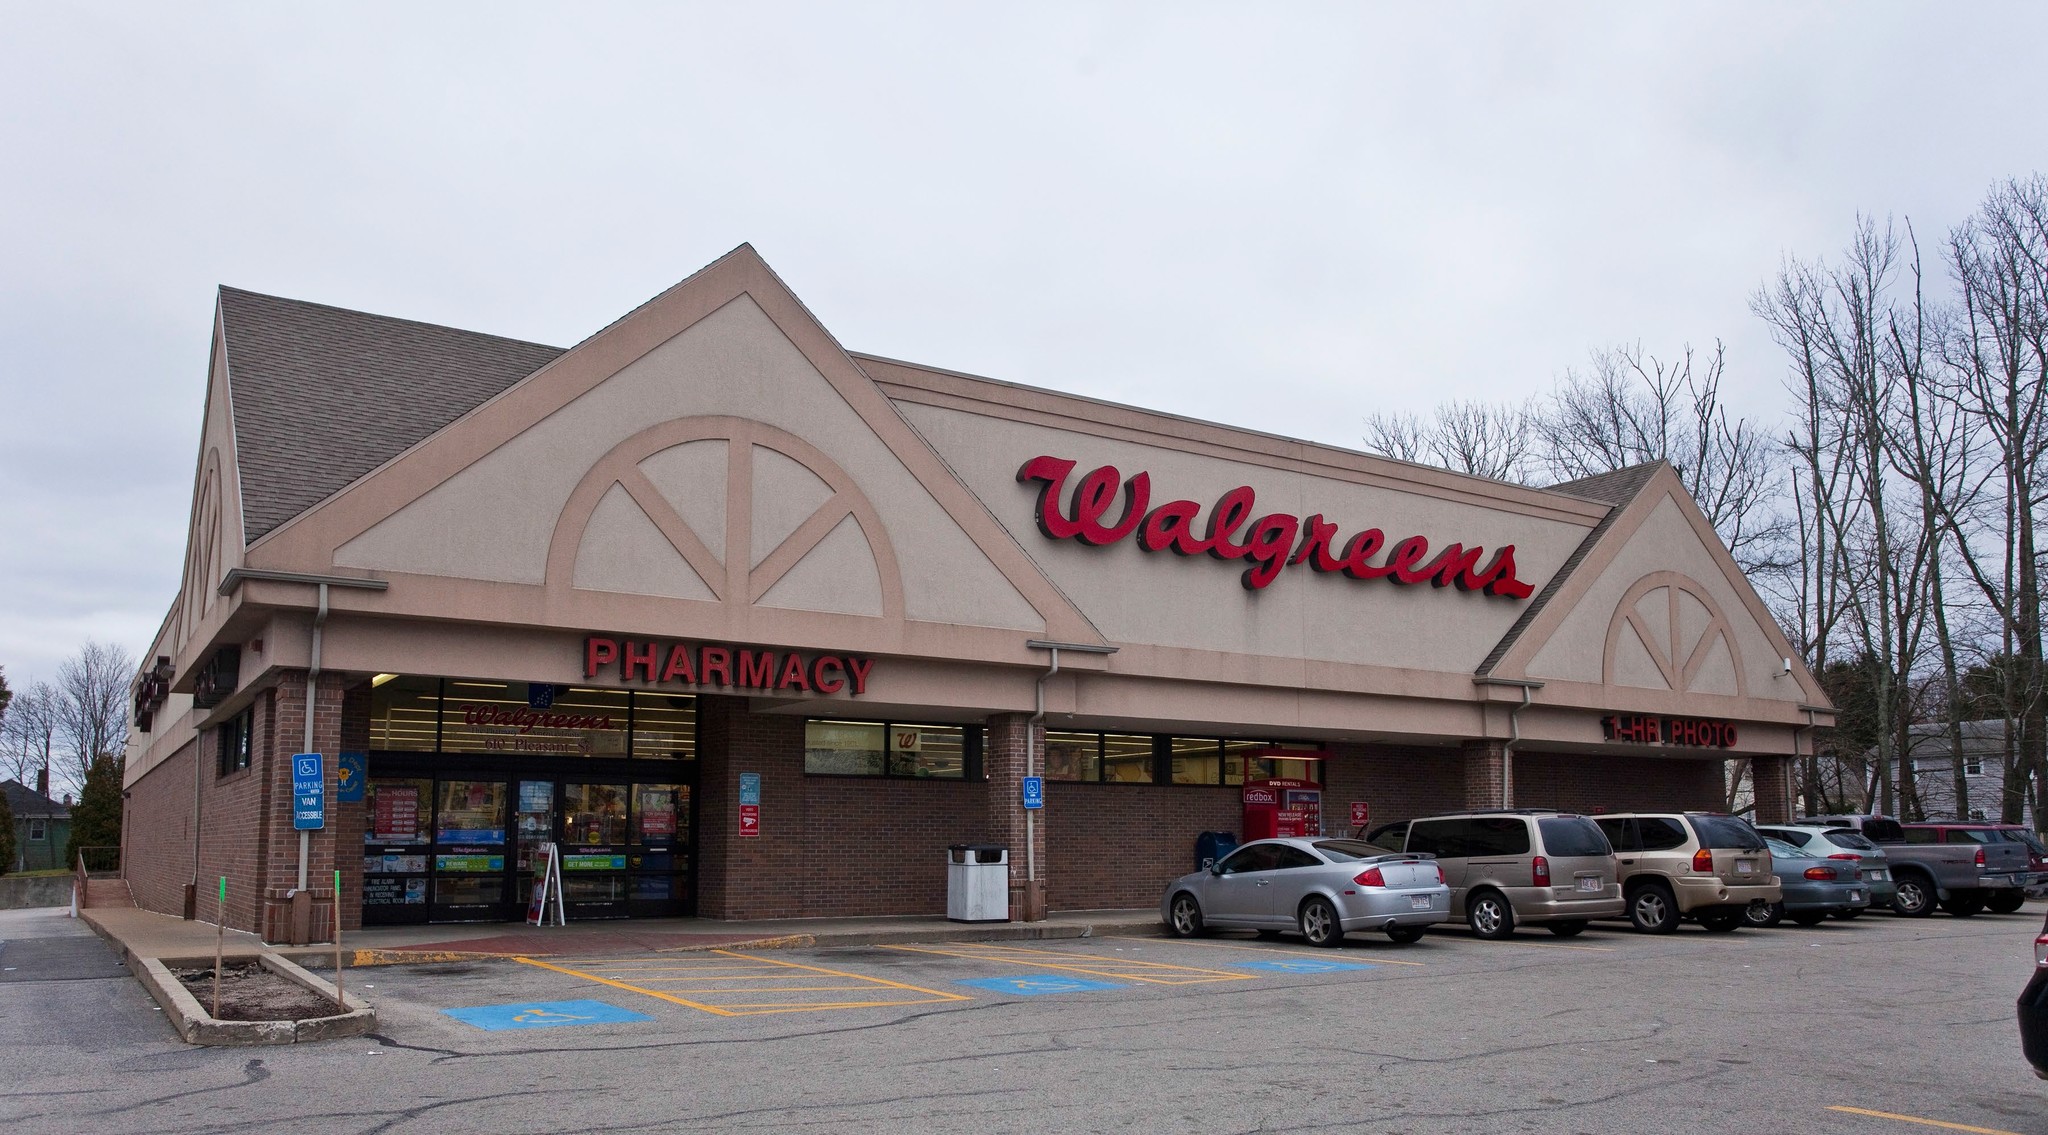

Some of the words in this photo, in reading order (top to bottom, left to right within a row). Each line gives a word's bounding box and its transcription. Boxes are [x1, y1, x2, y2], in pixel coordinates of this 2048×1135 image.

[1016, 455, 1535, 599] Walgreens
[584, 637, 875, 695] PHARMACY
[459, 704, 615, 734] Walgreens
[1601, 715, 1660, 743] 1-HR
[1665, 719, 1738, 747] PHOTO
[485, 738, 506, 750] 610
[515, 738, 569, 753] Pleasant
[295, 781, 323, 790] PARKING
[301, 797, 317, 806] VAN
[1246, 793, 1273, 802] redbox
[296, 811, 323, 820] ACCESSIBLE
